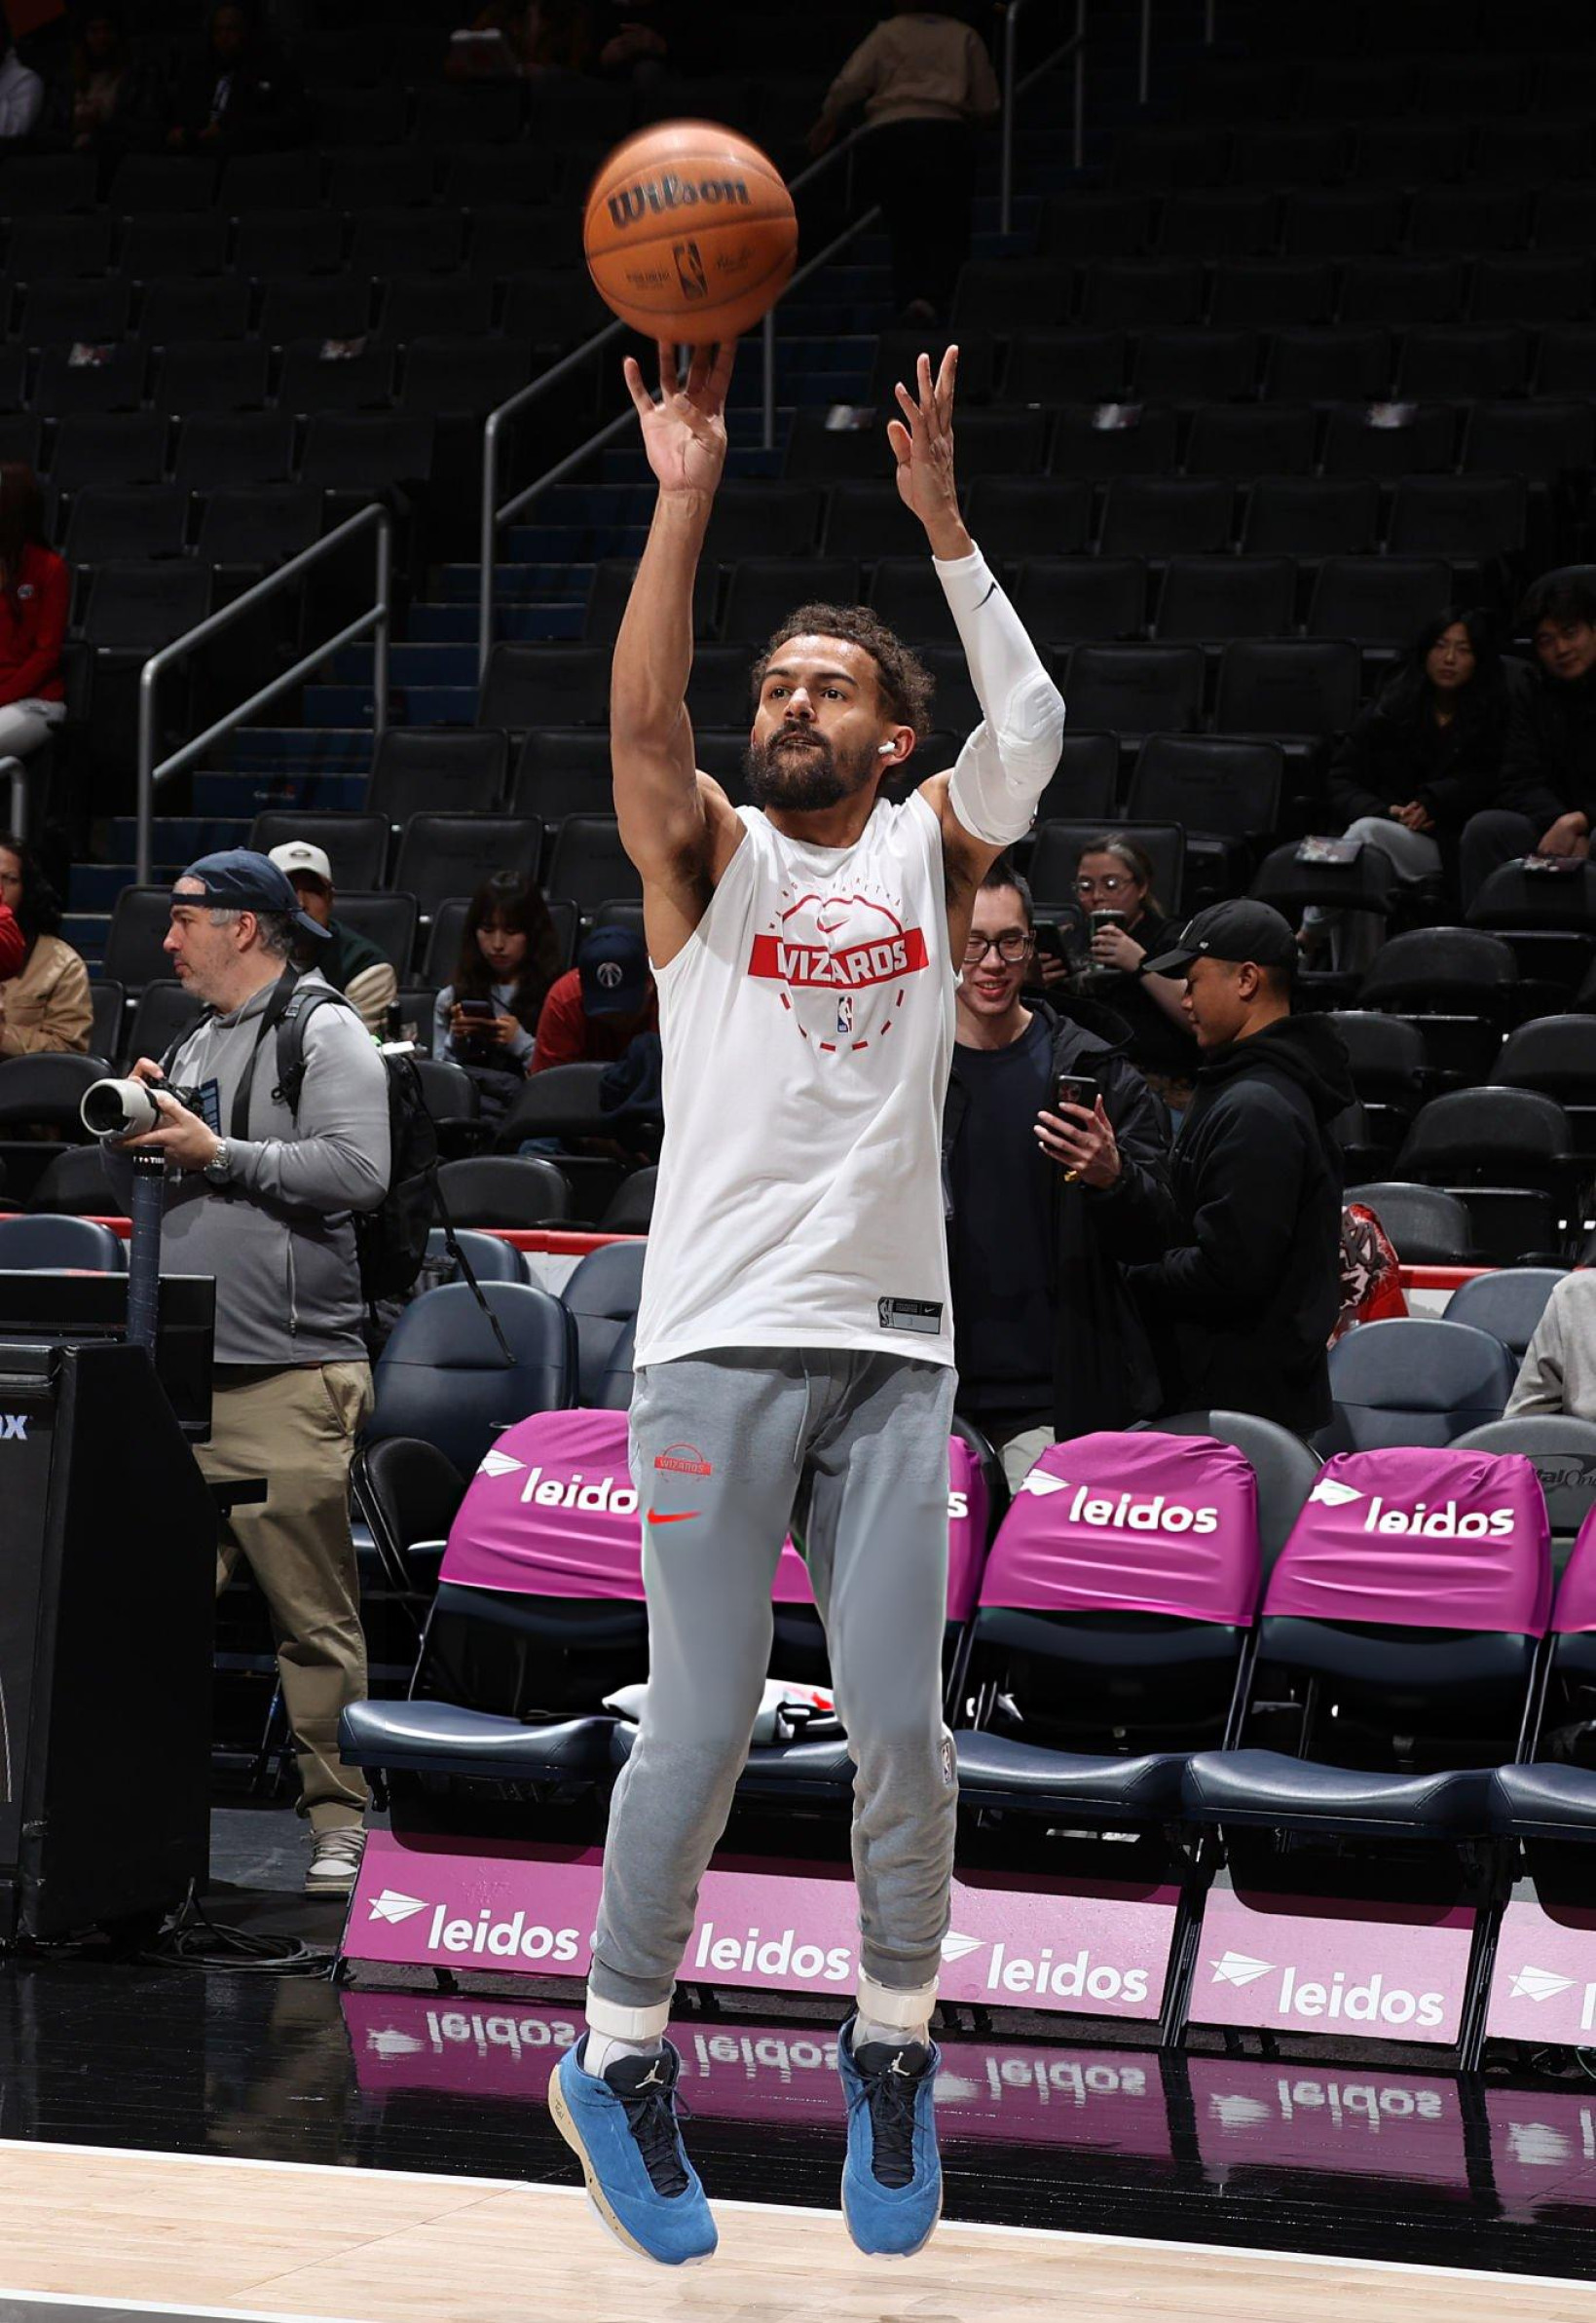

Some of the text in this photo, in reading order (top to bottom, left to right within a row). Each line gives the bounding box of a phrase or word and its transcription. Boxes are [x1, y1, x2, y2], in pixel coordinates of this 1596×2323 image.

[608, 173, 751, 228] Wilson
[776, 939, 908, 985] WIZARDS
[520, 1467, 639, 1515] leido
[1069, 1485, 1217, 1533] leidos
[1364, 1497, 1514, 1539] leidos
[427, 1904, 579, 1961] leidos
[694, 1922, 851, 1981] leidos
[986, 1942, 1150, 2003] leidos
[1278, 1966, 1444, 2027] leidos
